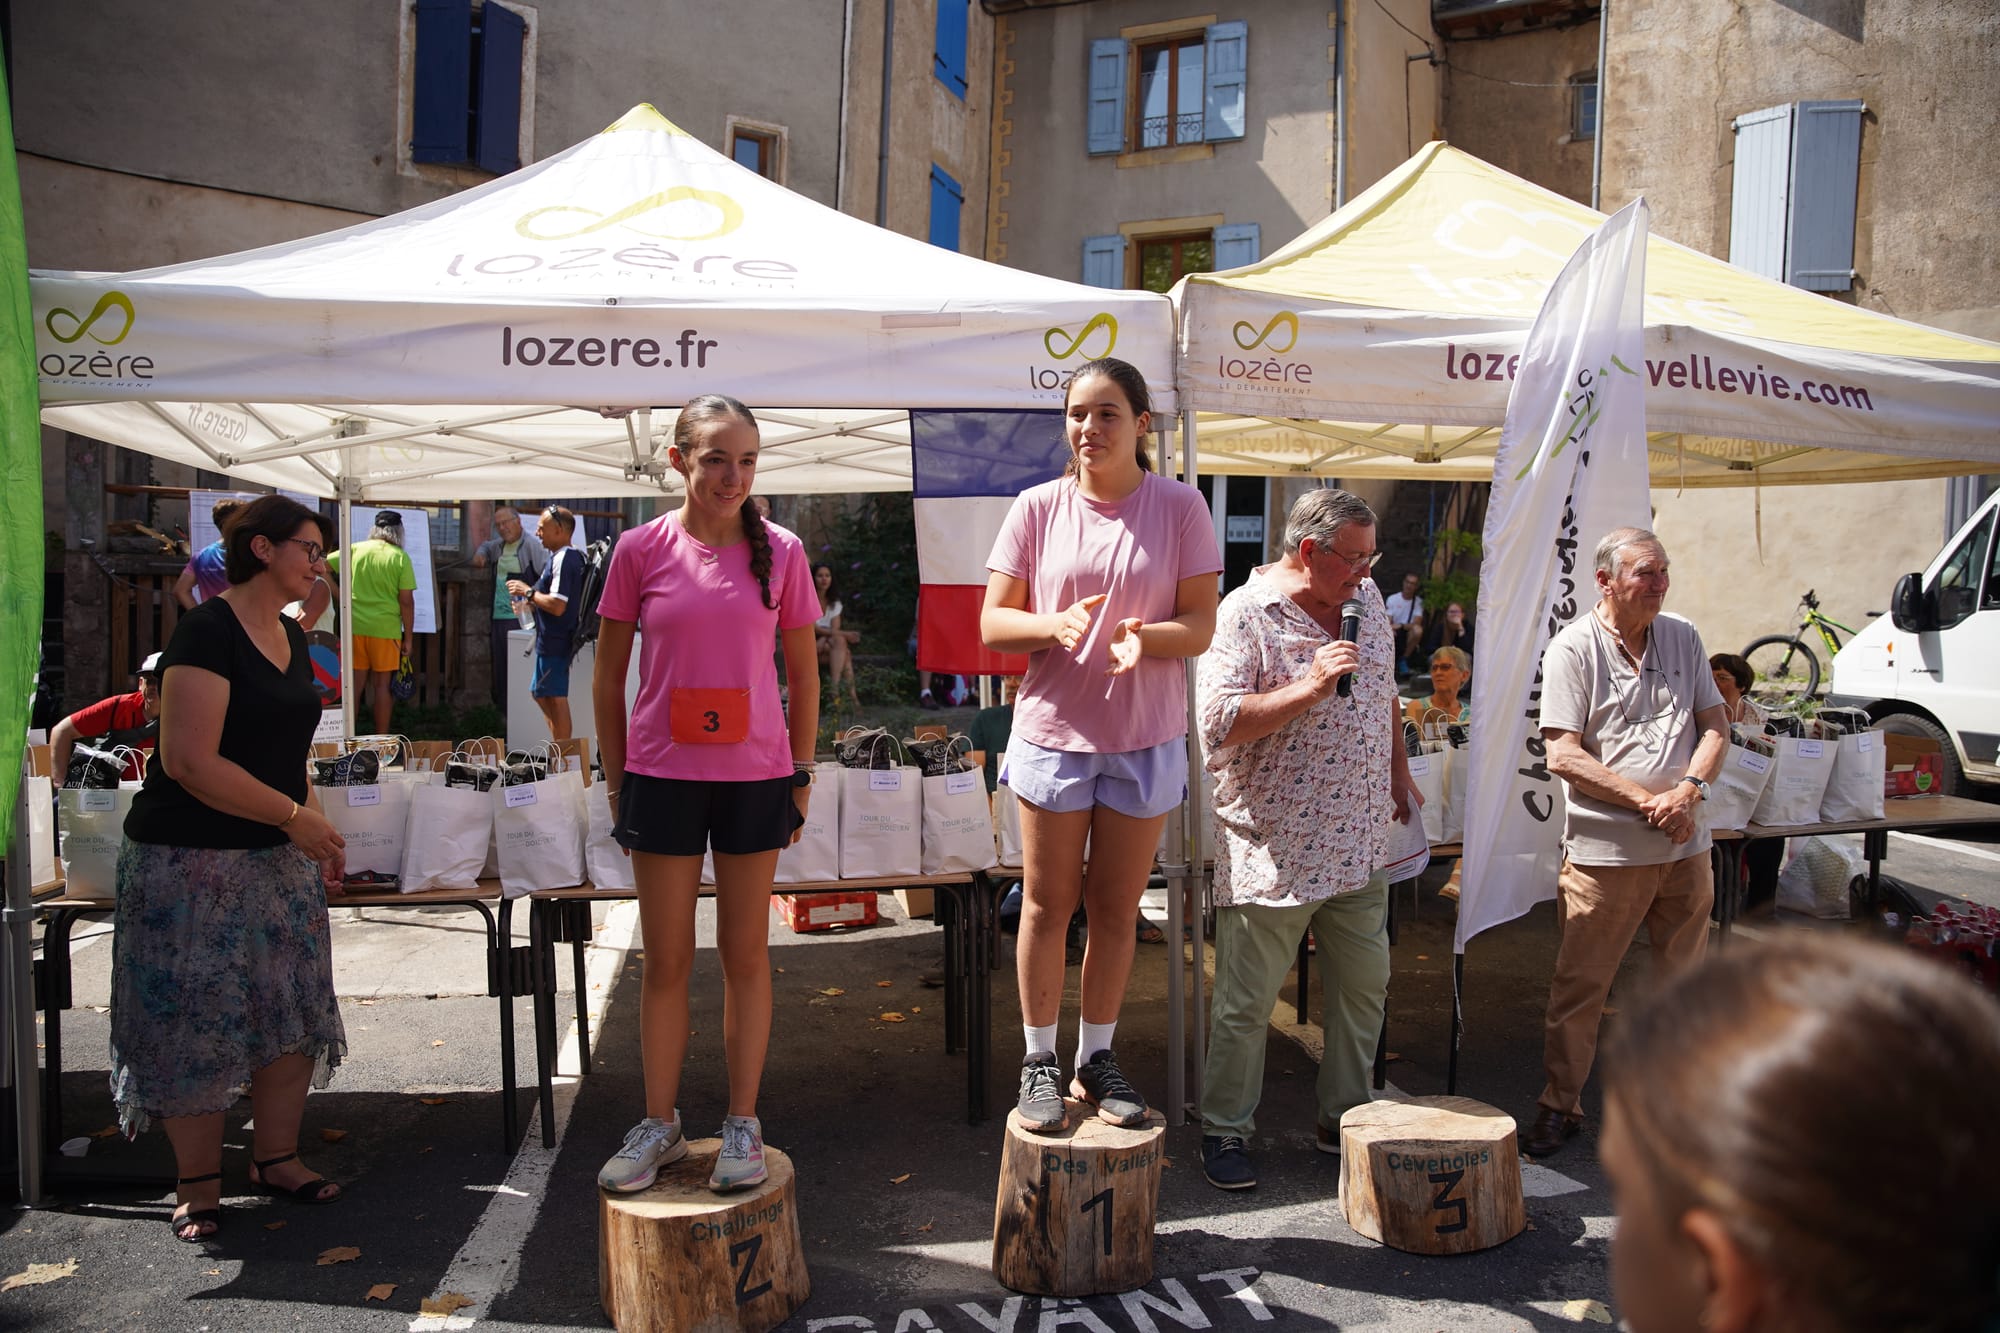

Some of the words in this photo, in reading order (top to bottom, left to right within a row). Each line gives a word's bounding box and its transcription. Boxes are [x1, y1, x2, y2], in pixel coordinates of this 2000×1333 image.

[446, 242, 799, 280] lozère
[502, 326, 719, 368] lozere.fr
[37, 350, 154, 379] ozère
[1029, 365, 1074, 390] loz
[1219, 355, 1313, 384] lozère
[703, 710, 720, 732] 3
[1045, 1153, 1087, 1175] Des
[1428, 1169, 1468, 1234] 3
[1081, 1187, 1114, 1256] 1
